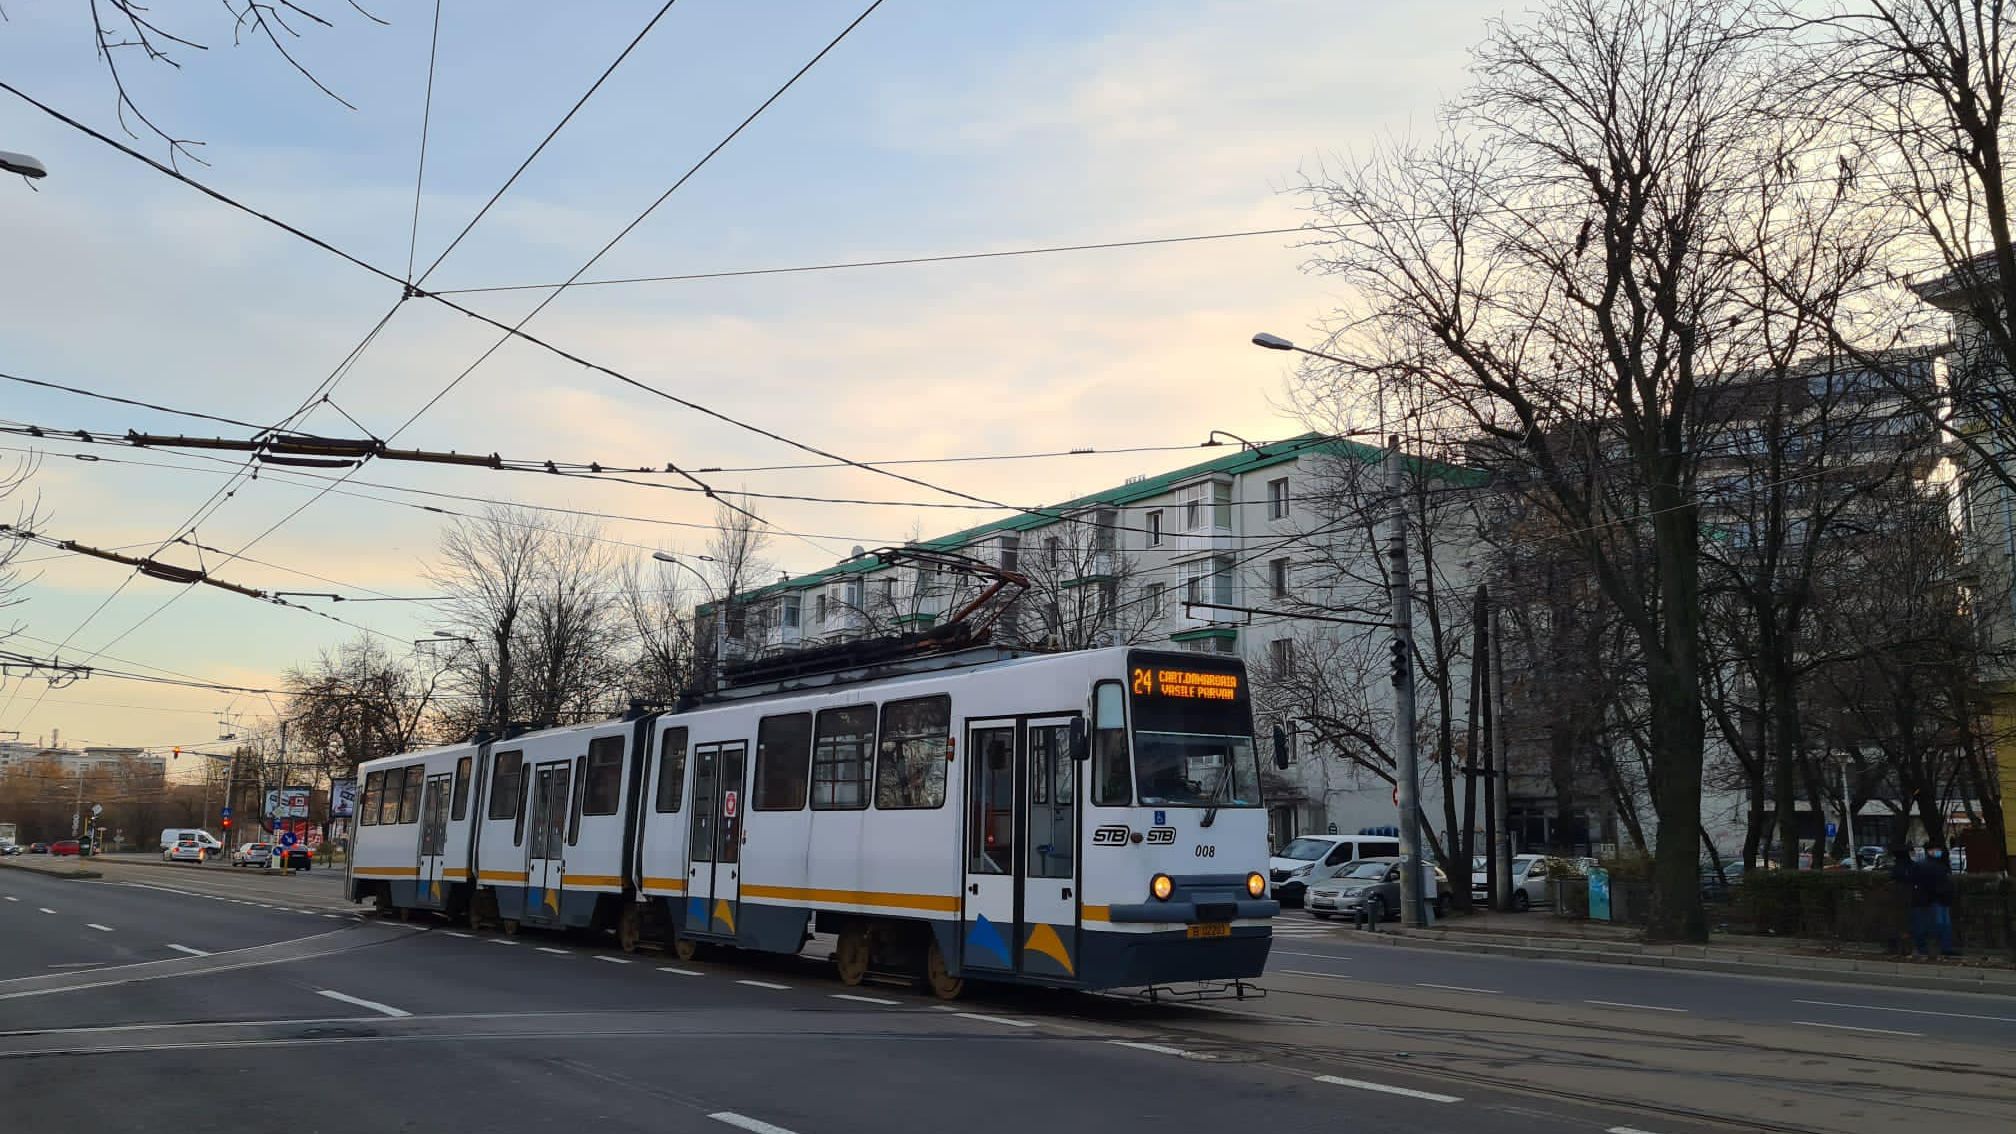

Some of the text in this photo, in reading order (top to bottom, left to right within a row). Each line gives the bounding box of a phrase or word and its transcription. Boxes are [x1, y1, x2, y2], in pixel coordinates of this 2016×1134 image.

[1133, 668, 1152, 695] 24
[1161, 685, 1234, 700] VASILE PARVAN
[1093, 829, 1126, 842] STB
[1146, 830, 1173, 842] STB
[1195, 844, 1215, 858] 008
